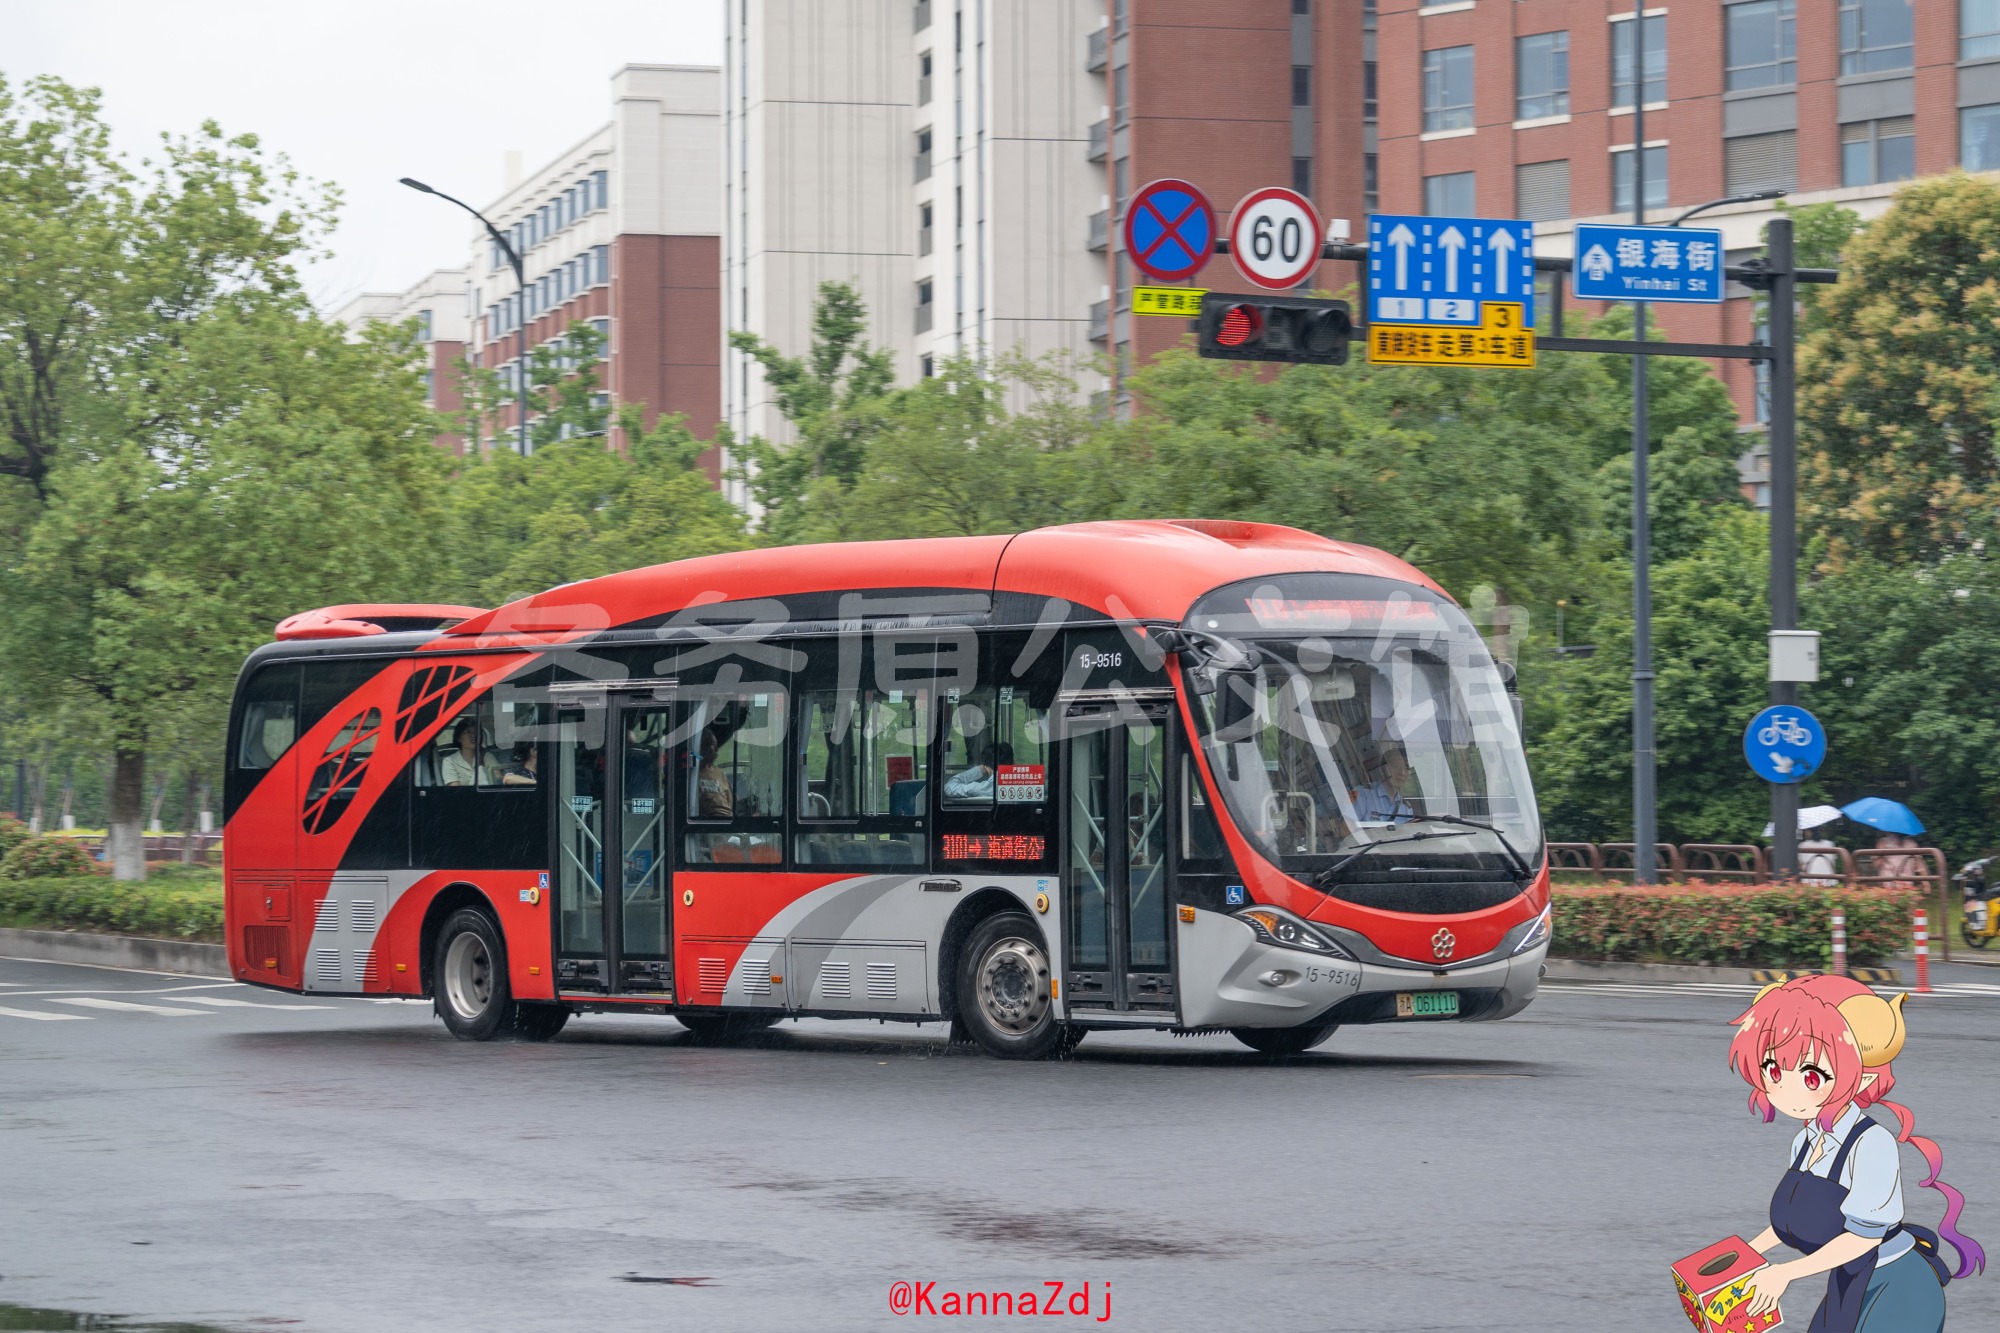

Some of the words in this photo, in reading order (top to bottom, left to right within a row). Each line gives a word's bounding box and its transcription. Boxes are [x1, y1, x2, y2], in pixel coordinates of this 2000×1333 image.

[1254, 215, 1300, 263] 60
[1616, 238, 1716, 271] 银海街
[1622, 276, 1680, 291] Yinhai
[1687, 278, 1708, 291] St
[1397, 301, 1405, 318] 1
[1445, 302, 1459, 318] 2
[1495, 307, 1510, 328] 3
[1080, 652, 1122, 668] 15-9516
[1305, 966, 1359, 987] 15-9516
